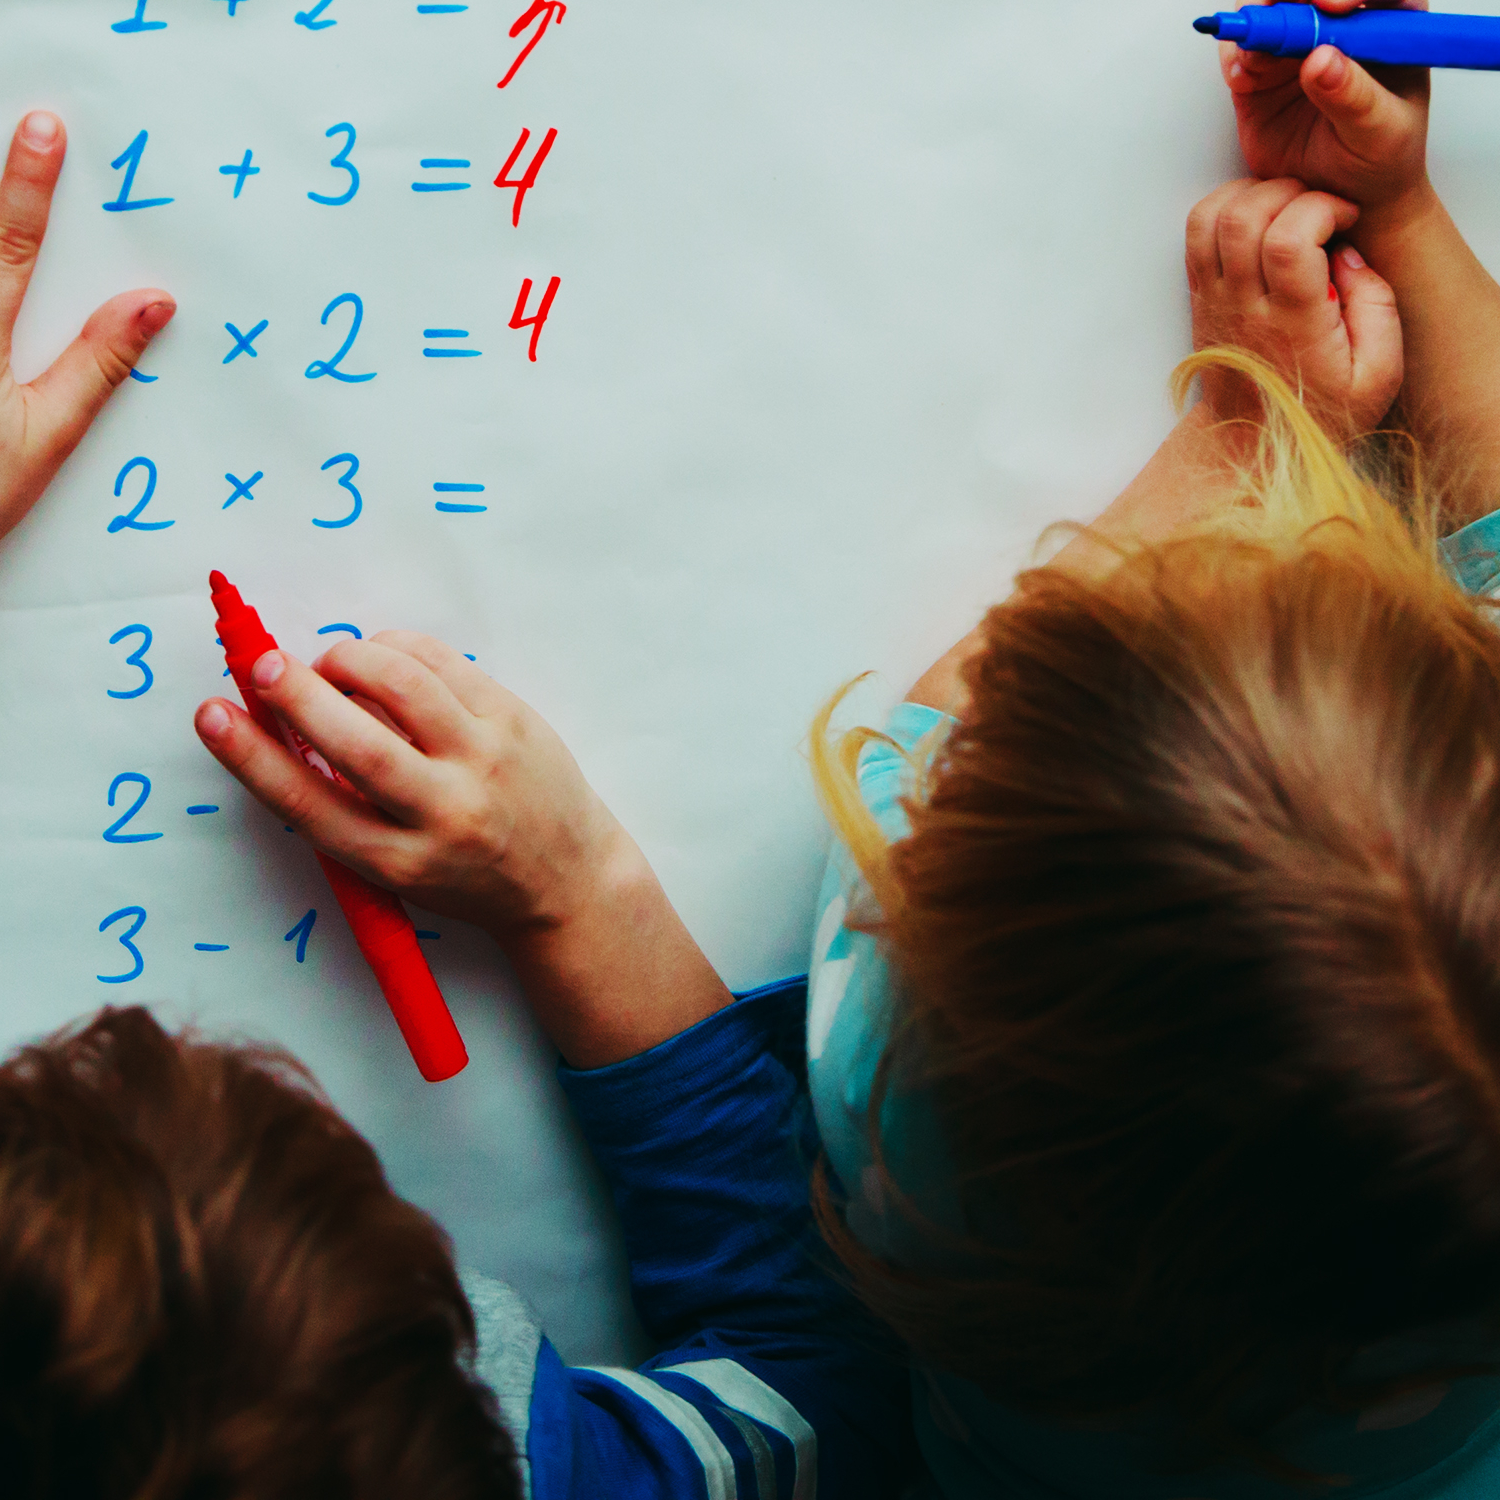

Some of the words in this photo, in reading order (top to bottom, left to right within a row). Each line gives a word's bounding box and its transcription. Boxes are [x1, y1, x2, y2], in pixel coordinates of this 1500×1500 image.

[102, 129, 175, 212] 1
[219, 149, 260, 199] +
[307, 122, 360, 206] 3
[493, 128, 558, 227] 4
[304, 292, 377, 383] 2
[508, 276, 561, 362] 4
[107, 456, 175, 534] 2
[312, 452, 363, 529] 3
[107, 623, 154, 699] 3
[102, 772, 164, 844] 2
[96, 905, 147, 984] 3
